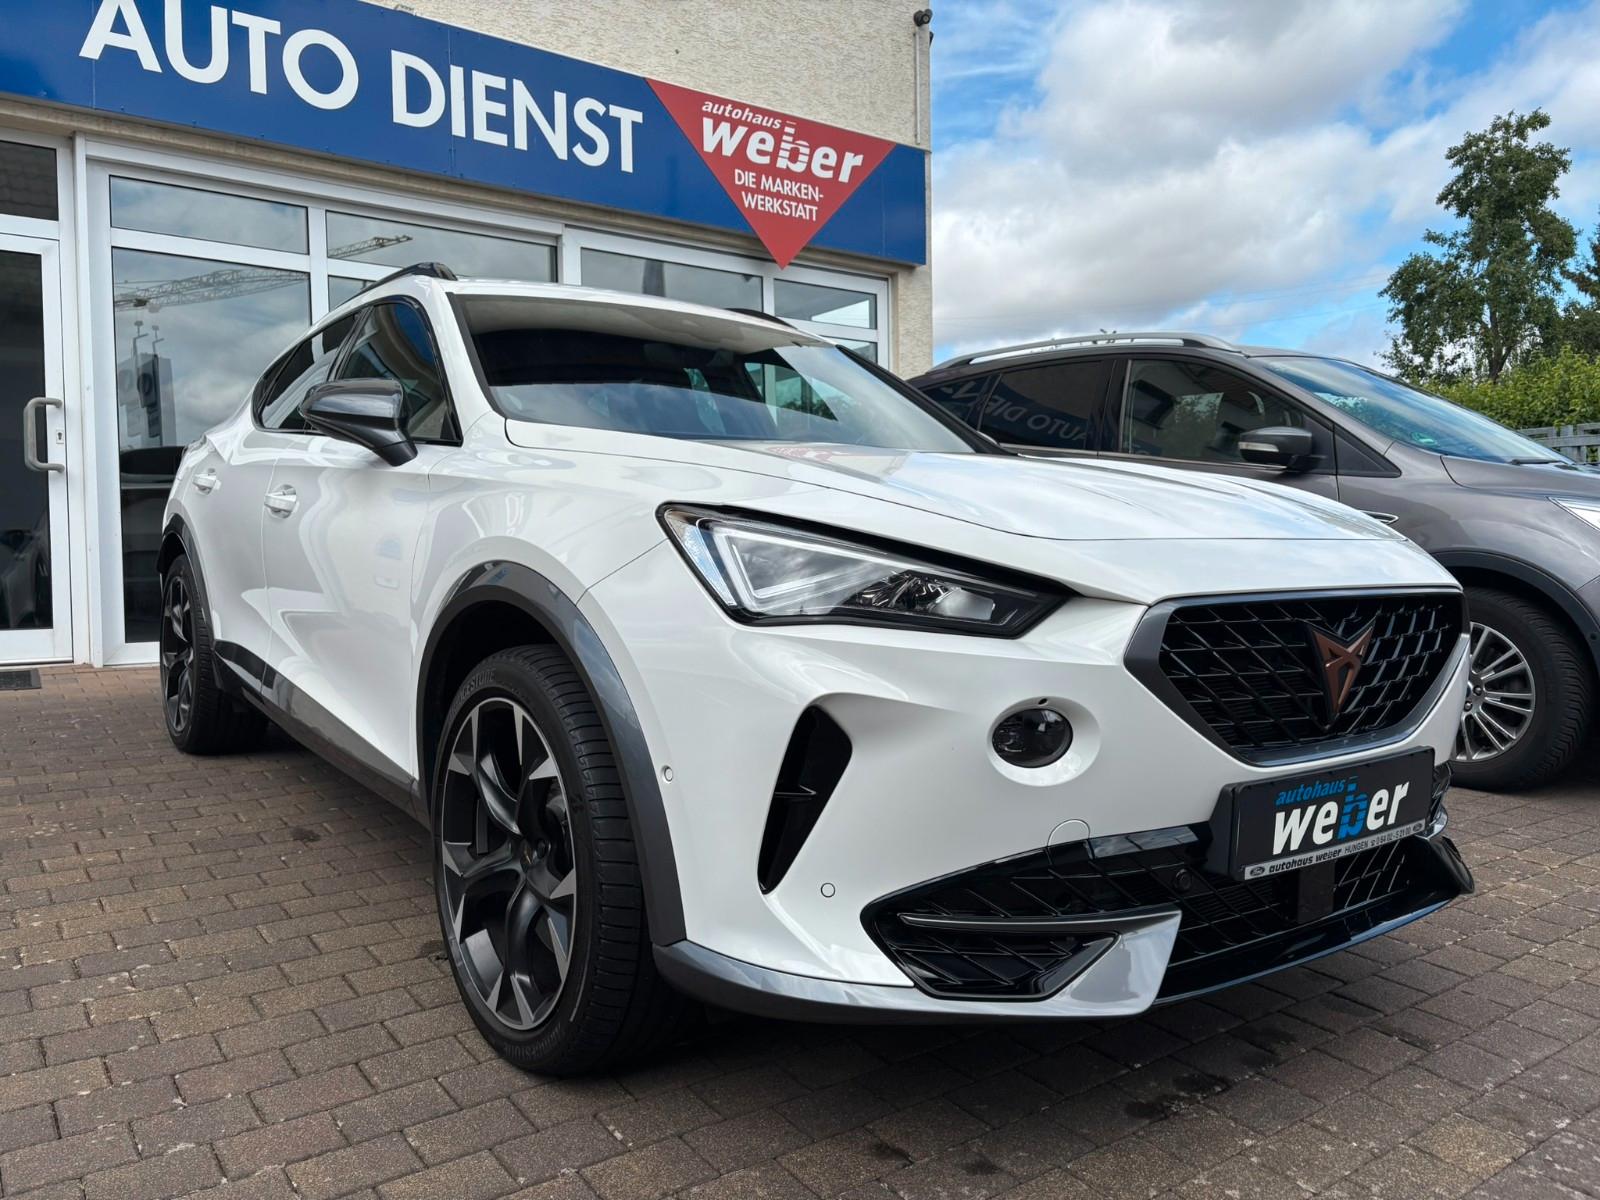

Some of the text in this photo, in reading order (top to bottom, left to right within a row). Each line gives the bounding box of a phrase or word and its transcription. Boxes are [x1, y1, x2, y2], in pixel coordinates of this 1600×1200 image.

[79, 0, 644, 174] AUTO DIENST
[702, 100, 782, 130] autohaus
[702, 117, 864, 184] weber
[734, 168, 824, 202] DIE MARKEN-
[741, 191, 819, 222] WERKSTATT
[1275, 778, 1346, 806] autohaus
[1272, 776, 1410, 855] weber
[1268, 855, 1314, 874] autohaus
[1315, 847, 1342, 863] weber
